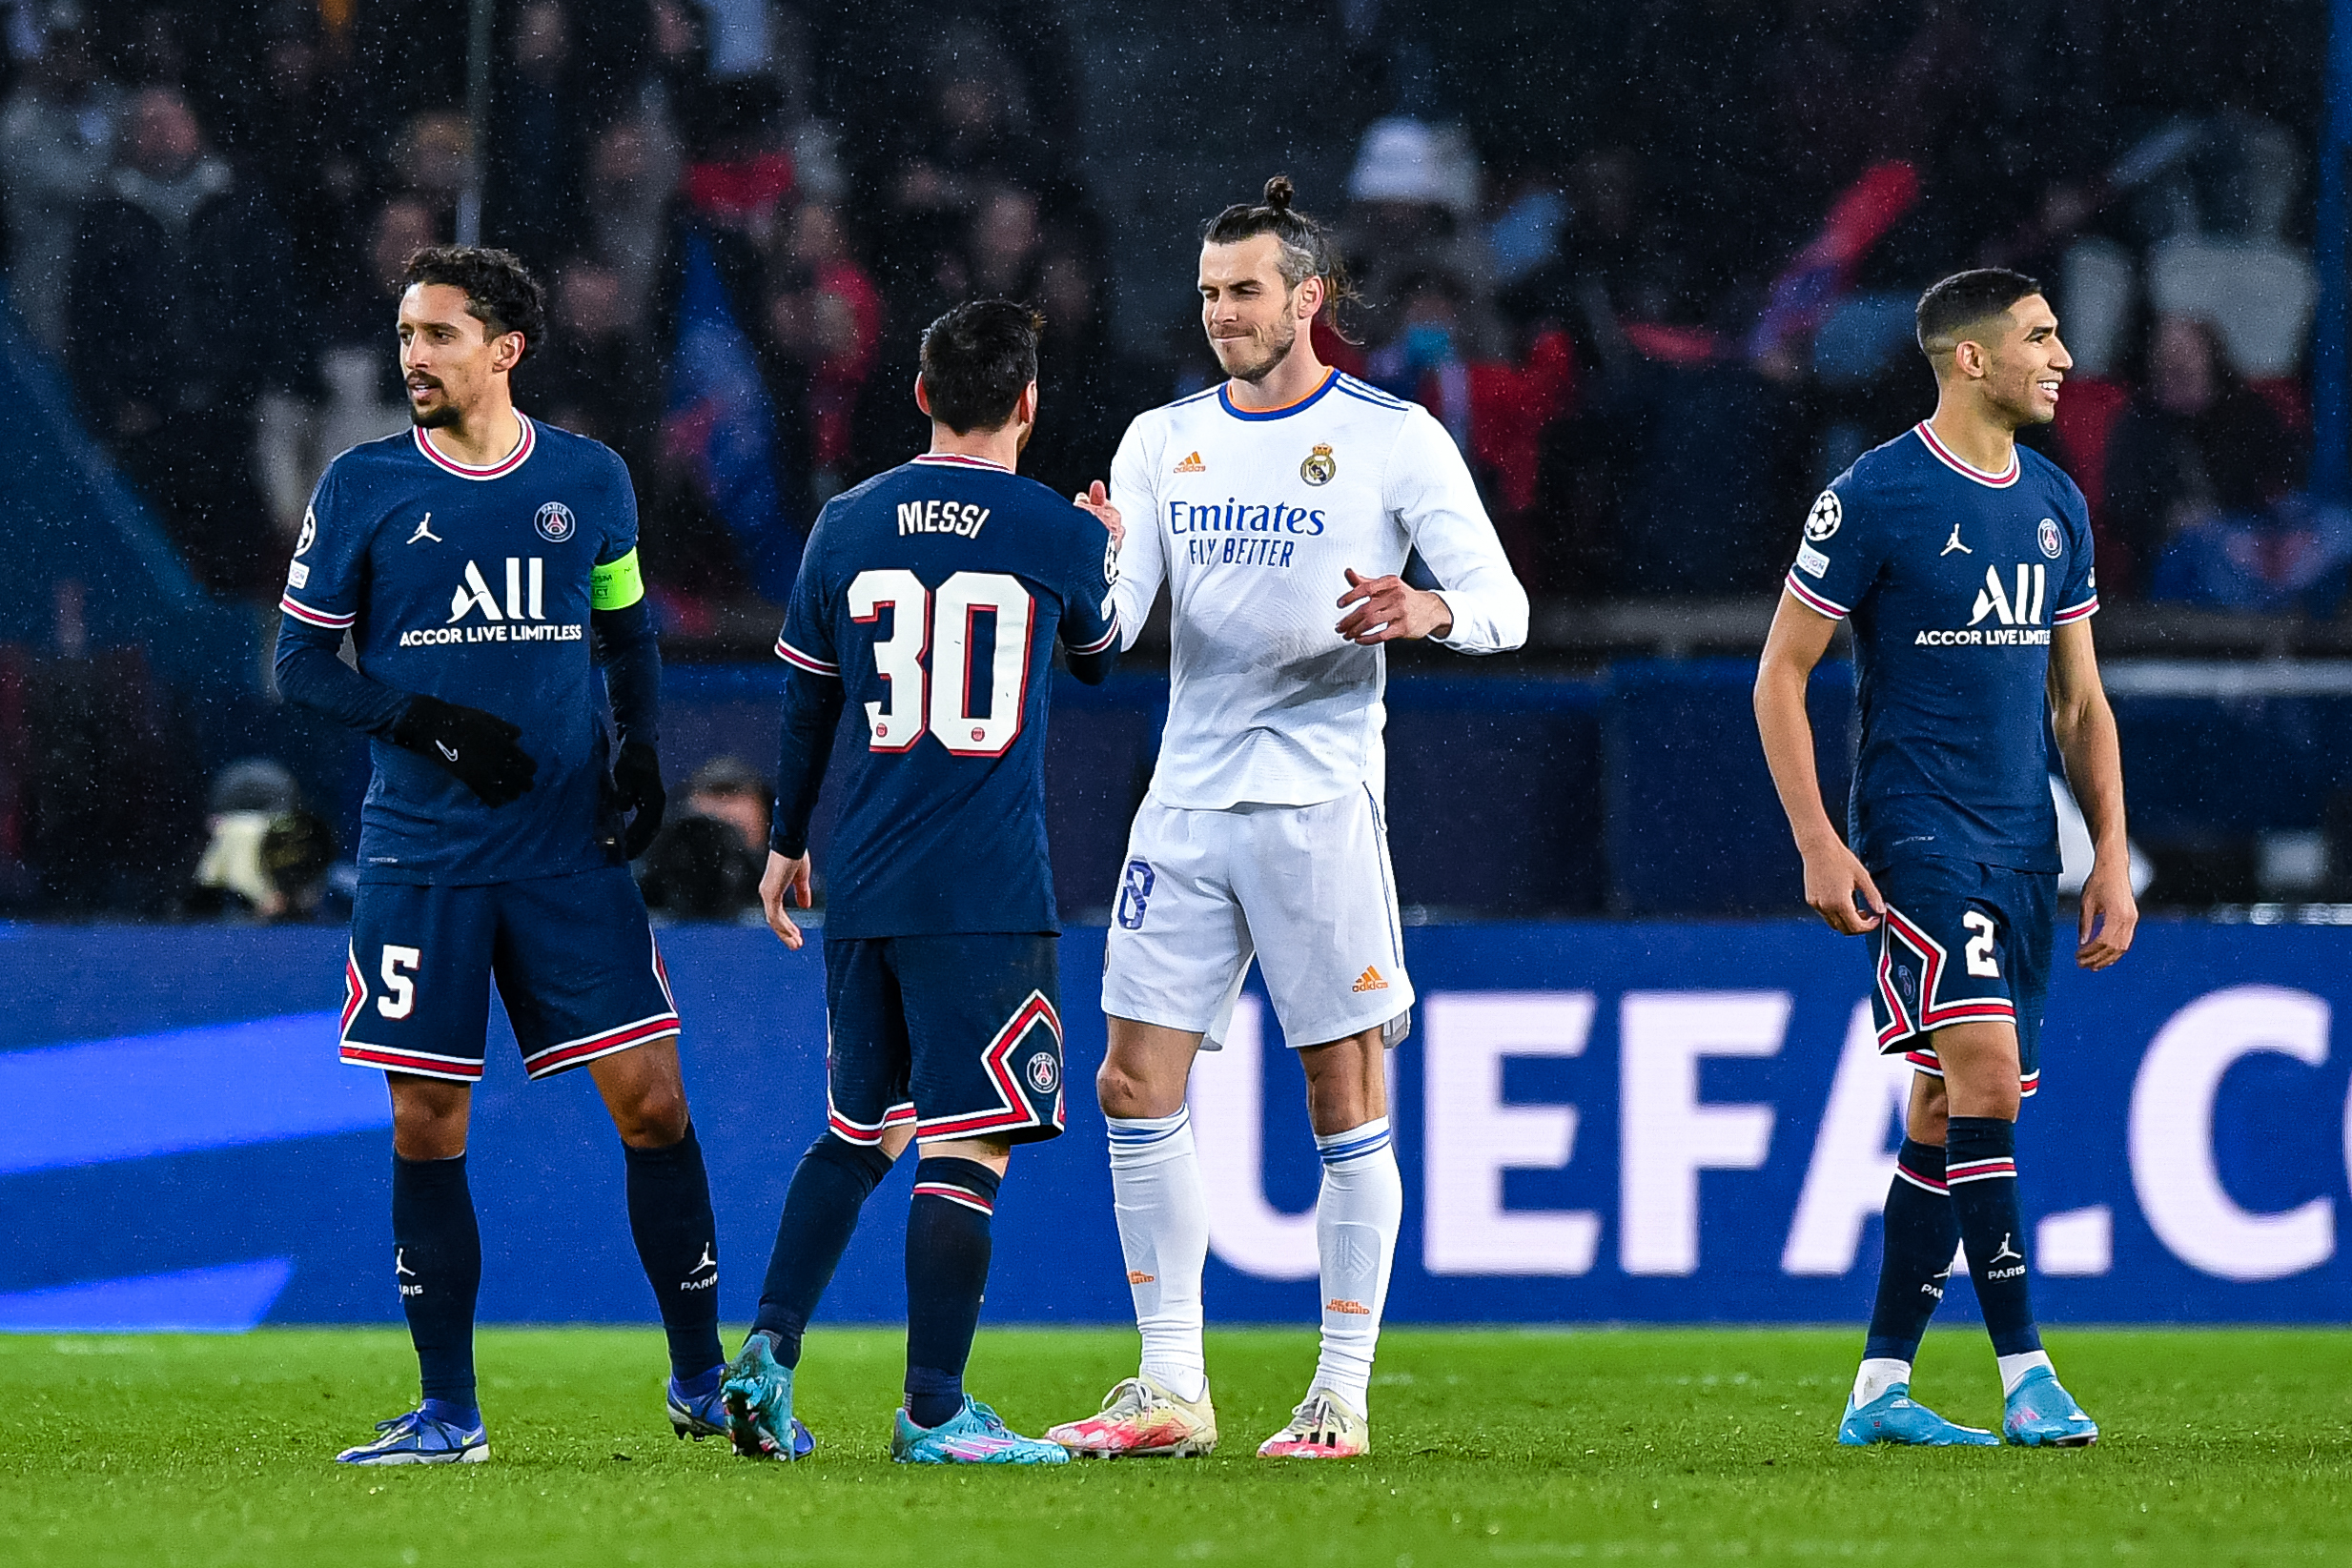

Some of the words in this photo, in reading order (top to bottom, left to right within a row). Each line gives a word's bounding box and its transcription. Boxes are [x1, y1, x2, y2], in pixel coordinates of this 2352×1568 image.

[897, 500, 991, 540] MESSI
[1170, 497, 1326, 537] Emirates
[1189, 538, 1217, 565] FLY
[1222, 538, 1295, 568] BETTER
[399, 627, 463, 647] ACCOR
[466, 625, 508, 643] LIVE
[511, 623, 583, 641] LIMITLESS
[1914, 629, 1983, 646] ACCOR
[1986, 629, 2018, 645] LIVE
[847, 569, 1036, 759] 30
[1962, 909, 2001, 979] 2
[378, 944, 423, 1021] 5
[1988, 1265, 2027, 1280] PARIS
